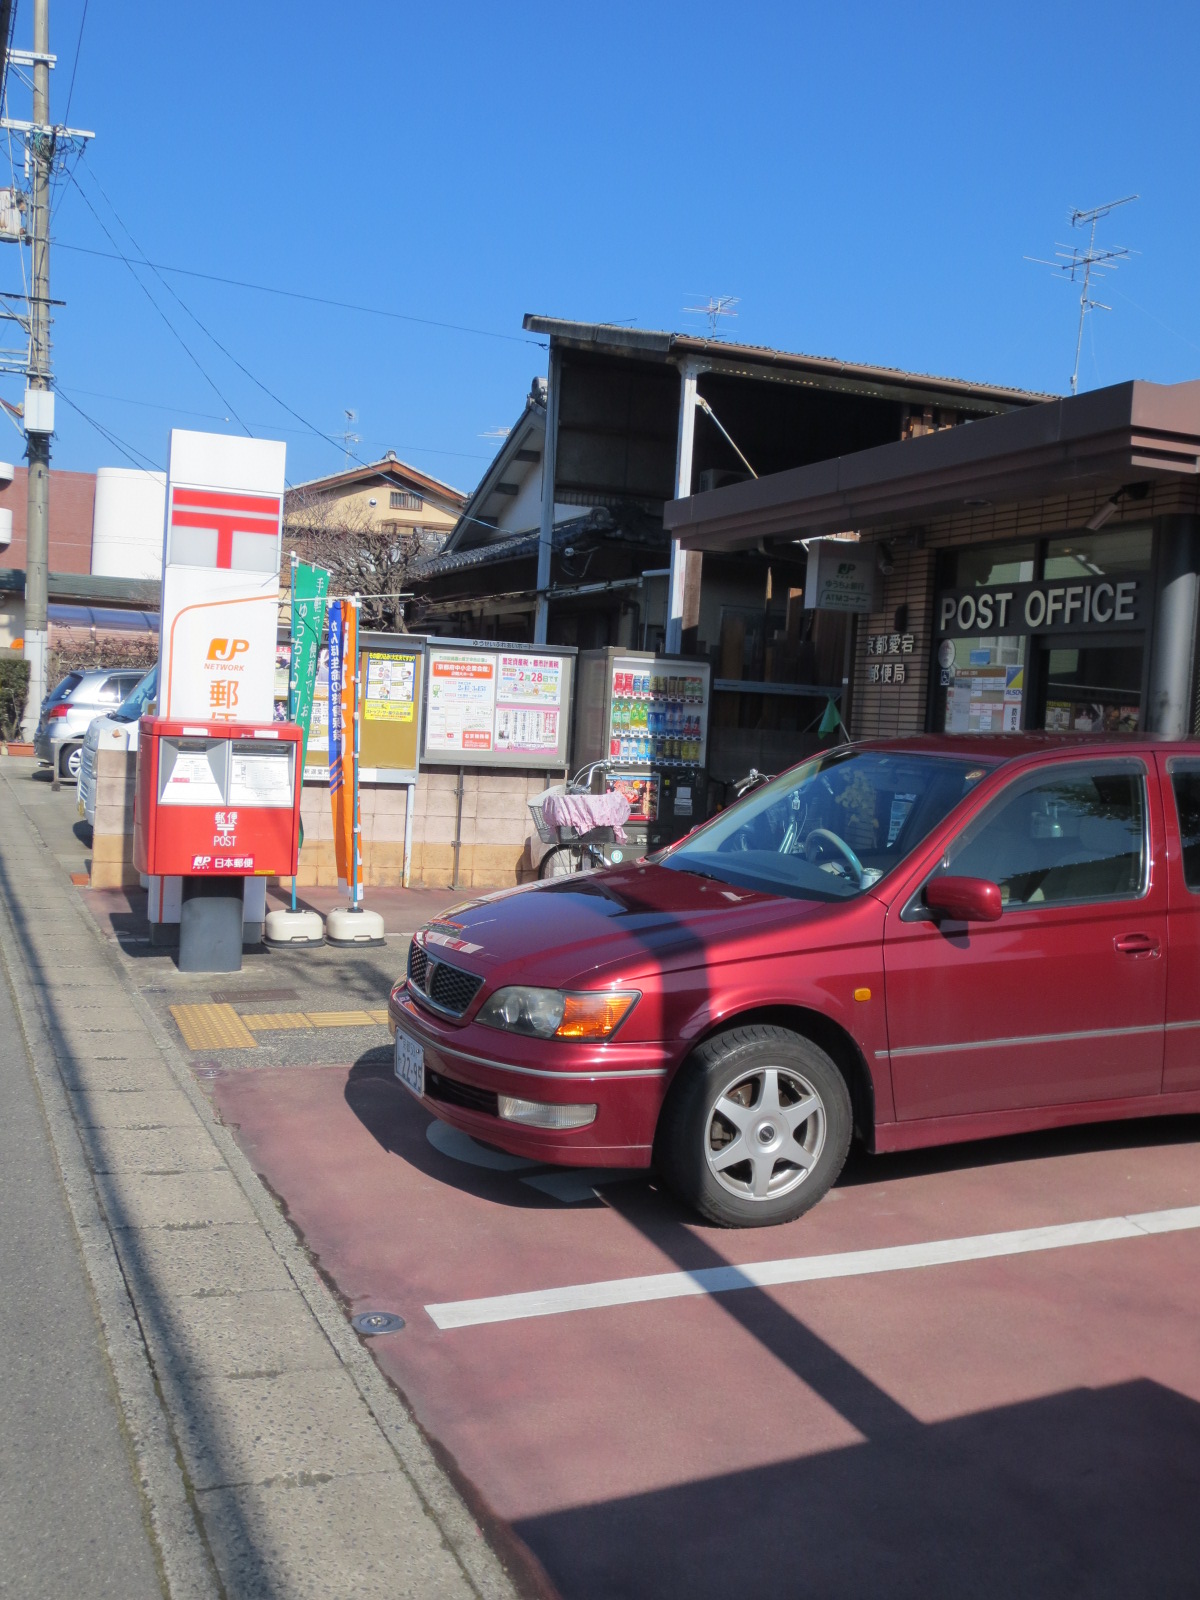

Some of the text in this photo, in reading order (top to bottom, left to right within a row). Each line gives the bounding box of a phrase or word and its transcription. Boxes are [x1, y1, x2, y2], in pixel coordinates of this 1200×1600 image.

[940, 581, 1136, 630] POST OFFICE
[203, 663, 246, 672] NETWORK
[868, 663, 906, 684] 郵便局
[215, 811, 238, 825] 郵便
[213, 836, 237, 847] POST
[214, 857, 254, 869] 日本郵便
